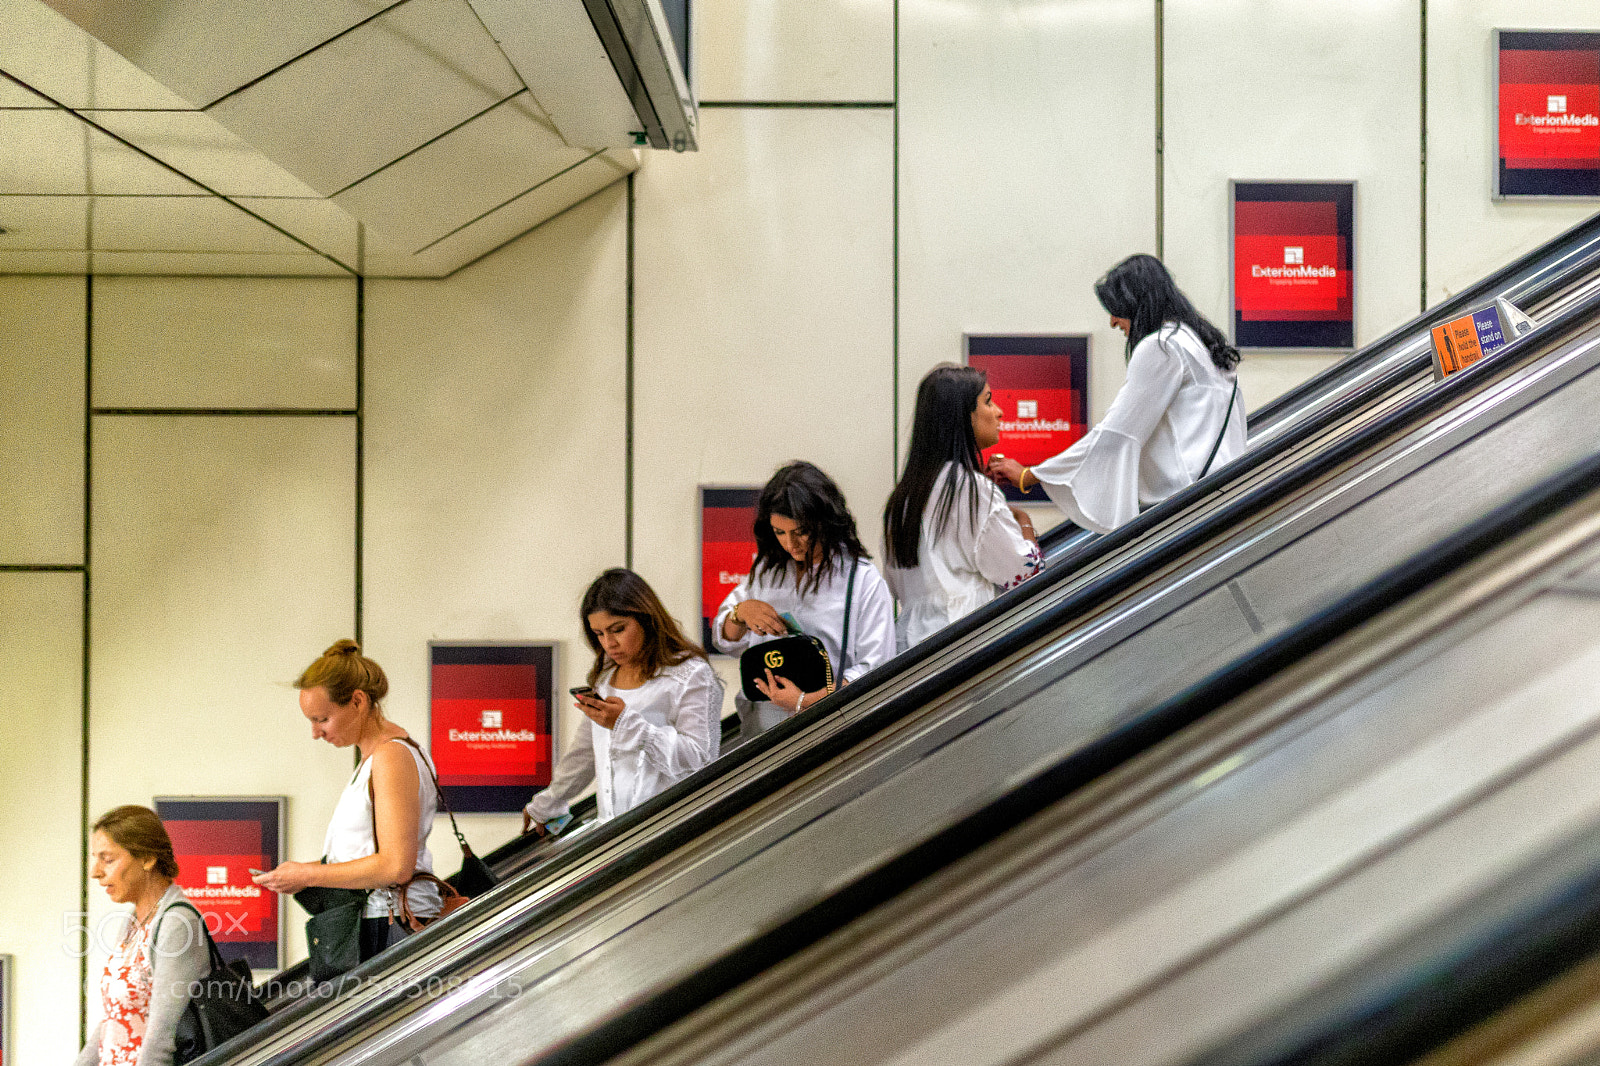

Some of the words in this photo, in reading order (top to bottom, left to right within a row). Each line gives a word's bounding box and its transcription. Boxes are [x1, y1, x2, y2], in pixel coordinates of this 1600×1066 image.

[1515, 113, 1599, 126] ExterionMedia
[1252, 265, 1336, 277] ExterionMedia
[1477, 321, 1493, 332] Please
[1481, 331, 1494, 344] stand
[1494, 331, 1502, 340] on
[997, 419, 1070, 431] terionMedia
[449, 729, 536, 741] ExterionMedia
[182, 885, 261, 897] xterionMedia
